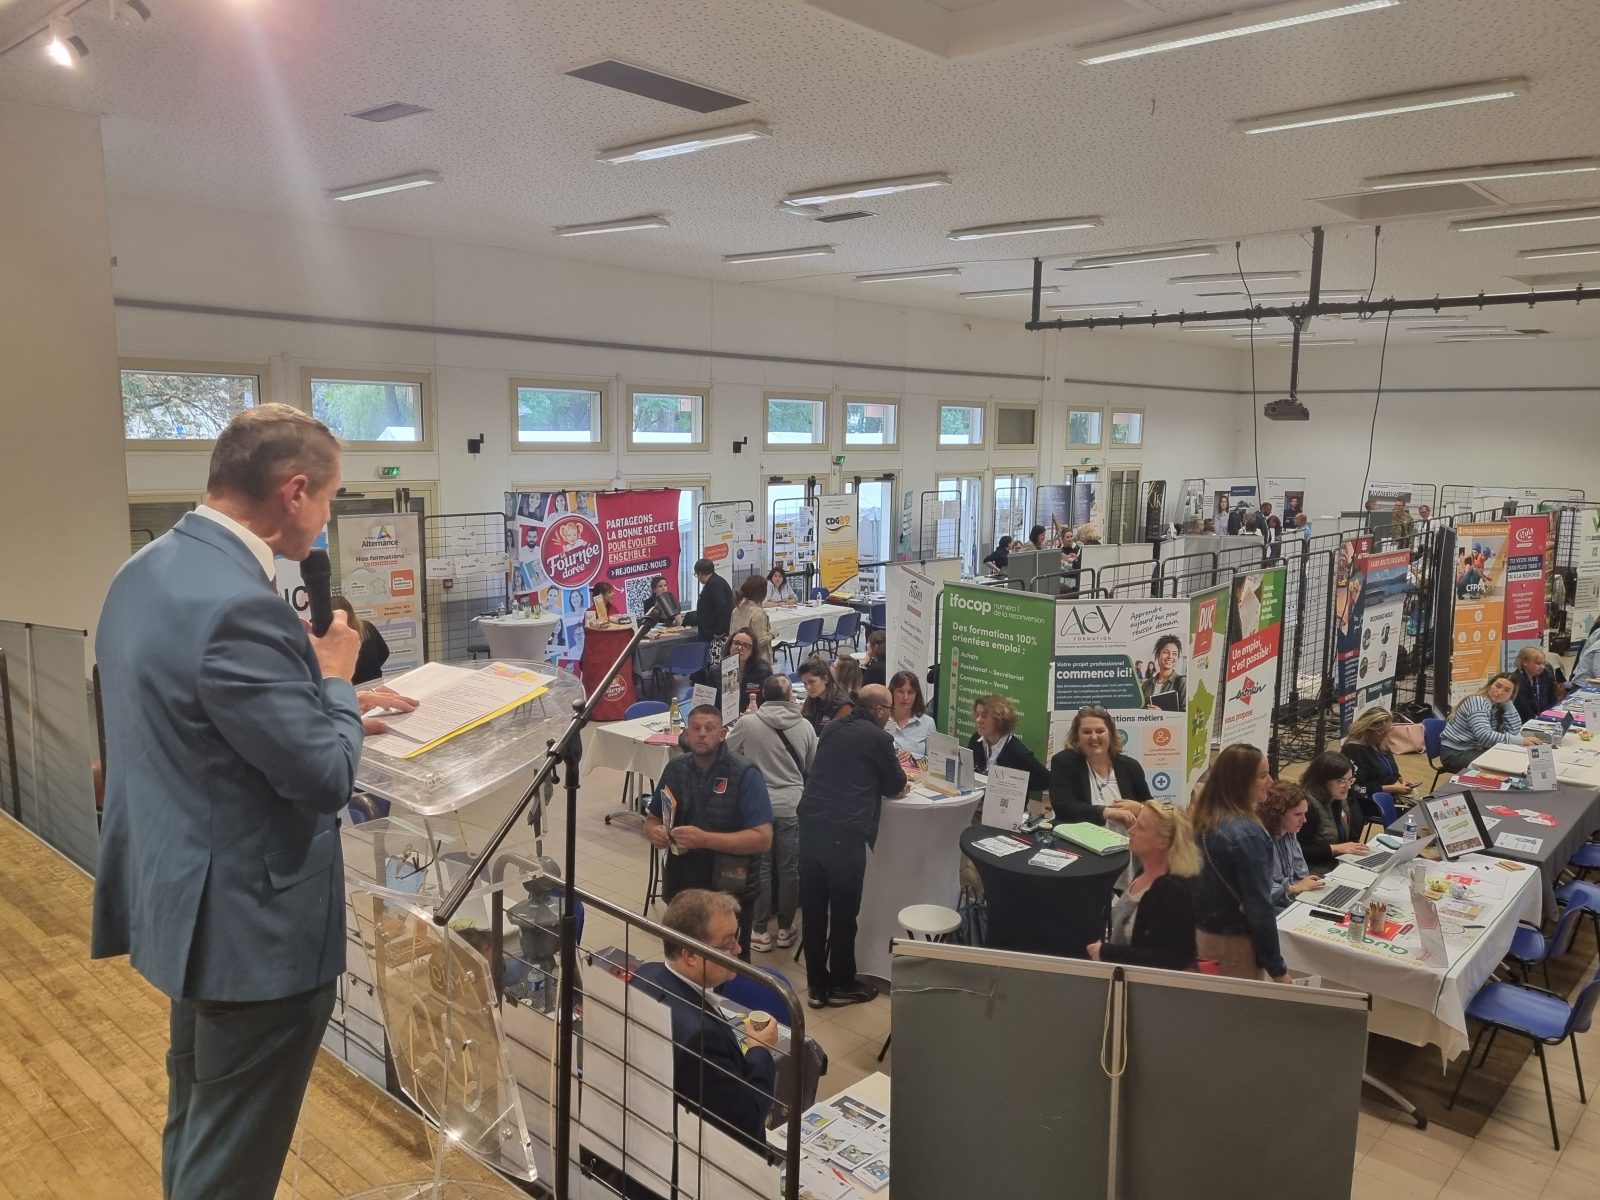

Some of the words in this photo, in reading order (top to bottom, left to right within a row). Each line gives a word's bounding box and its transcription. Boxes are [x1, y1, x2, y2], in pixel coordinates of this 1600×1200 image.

[606, 514, 653, 529] PARTAGEONS
[606, 532, 617, 541] LA
[617, 527, 643, 539] BONNE
[643, 521, 675, 533] RECETTE
[361, 540, 399, 548] Alternance
[607, 541, 626, 552] POUR
[547, 542, 600, 577] Fournée
[608, 549, 647, 563] ENSEMBLE
[562, 563, 585, 579] dorée
[615, 559, 667, 576] REJOIGNEZ-NOUS
[949, 592, 992, 615] ifocop
[993, 602, 1017, 612] numéro
[1008, 613, 1046, 624] reconversion
[1130, 606, 1163, 621] Apprendre
[1165, 610, 1180, 620] pour
[1198, 604, 1215, 633] DUC
[952, 621, 968, 632] Des
[969, 624, 1014, 641] formations
[1016, 634, 1038, 646] 100%
[1131, 625, 1154, 636] réussir
[952, 634, 990, 648] orientées
[991, 641, 1021, 654] emploi
[960, 651, 979, 660] Achats
[1231, 661, 1246, 674] c'est
[1246, 647, 1269, 669] possible
[1232, 648, 1241, 660] Un
[960, 662, 988, 673] Assistanat
[993, 669, 1024, 681] Secrétariat
[1089, 660, 1125, 668] professionnel
[960, 673, 989, 685] Commerce
[993, 681, 1009, 690] Vente
[1056, 669, 1116, 680] commence
[1137, 713, 1164, 722] métiers
